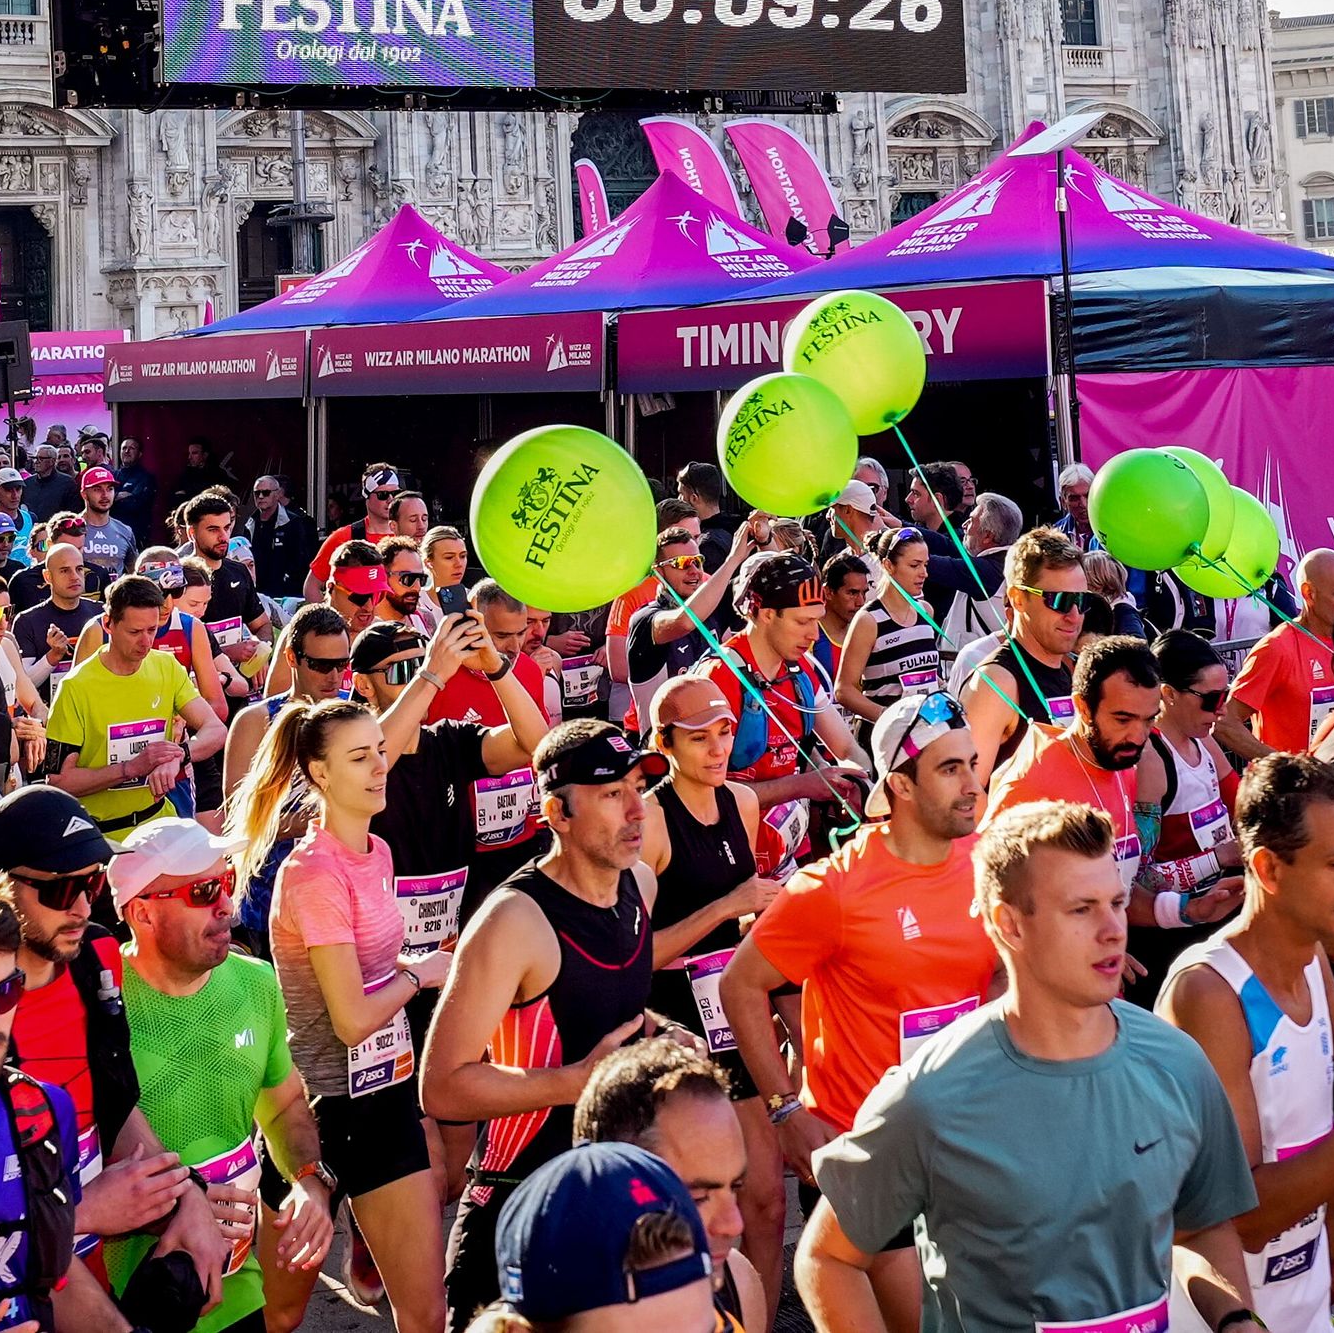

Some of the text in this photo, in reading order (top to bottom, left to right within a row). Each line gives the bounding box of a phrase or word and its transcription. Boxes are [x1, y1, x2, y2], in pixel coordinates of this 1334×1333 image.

[275, 38, 423, 67] Orologi dal 1902
[1113, 213, 1186, 225] WIZZ AIR
[911, 222, 978, 237] WIZZ AIR
[1124, 222, 1199, 234] MILANO
[896, 232, 968, 248] MILANO
[886, 244, 955, 257] MARATHON
[553, 261, 602, 271] WIZZ AIR
[711, 254, 781, 264] WIZZ AIR
[720, 262, 789, 272] MILANO
[431, 278, 493, 286] WIZZ AIR
[539, 270, 590, 280] MILANO
[676, 320, 783, 368] TIMIN
[801, 309, 884, 365] FESTINA
[29, 345, 105, 362] MARATHO
[364, 345, 531, 368] WIZZ AIR MILANO MARATHON
[568, 351, 592, 359] MILANO
[140, 358, 256, 377] WIZZ AIR MILANO MARATHON
[45, 383, 104, 396] MARATHO
[724, 397, 795, 470] FESTINA
[525, 462, 601, 569] FESTINA
[83, 540, 119, 557] Jeep
[898, 652, 938, 671] FULHAM
[497, 793, 517, 810] GAETANO
[501, 810, 513, 821] 649
[418, 898, 449, 919] CHRISTIAN
[423, 918, 442, 933] 9216
[376, 1033, 395, 1051] 9022
